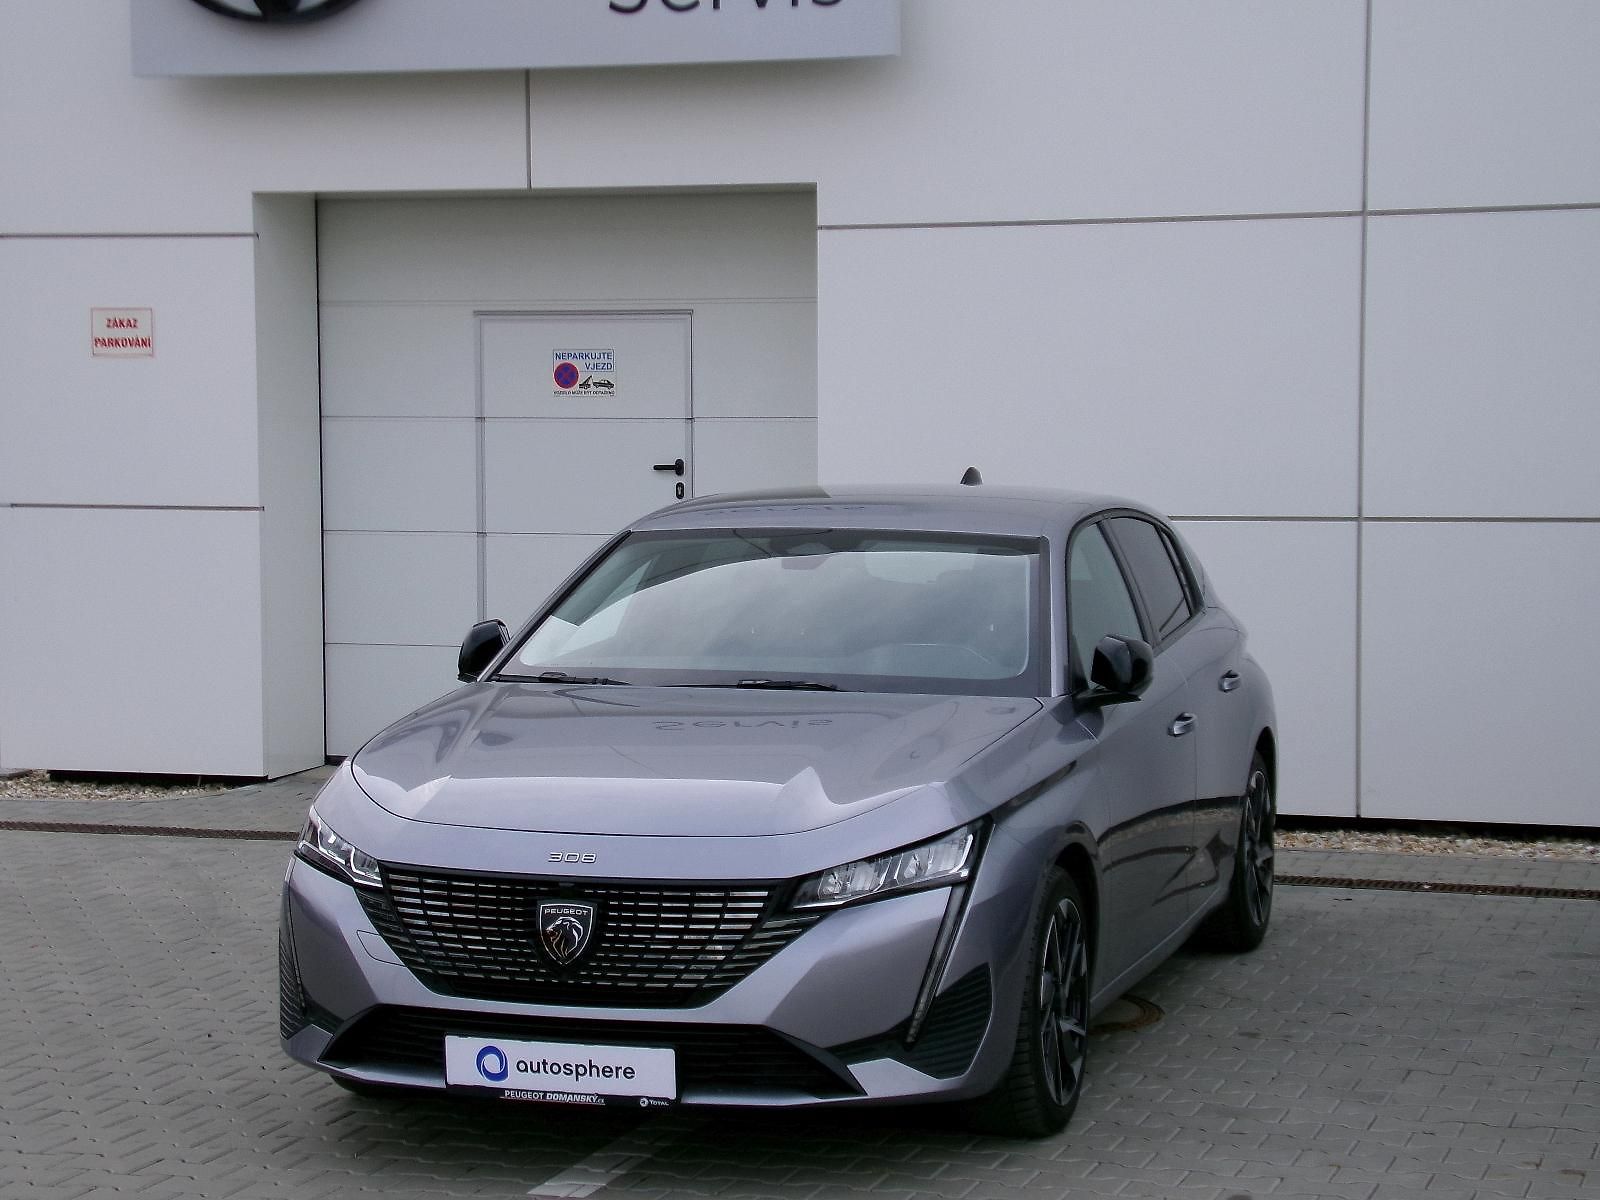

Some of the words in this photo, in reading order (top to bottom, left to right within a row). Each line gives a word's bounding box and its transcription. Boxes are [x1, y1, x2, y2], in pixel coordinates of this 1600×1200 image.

[106, 317, 138, 328] ZÁKAZ
[555, 352, 612, 360] NEPARKUJTE
[585, 362, 612, 370] VJEZD
[548, 852, 597, 863] 308
[544, 908, 589, 916] PEUGEOT
[516, 1059, 636, 1082] autosphere
[504, 1089, 545, 1100] PEUGEOT
